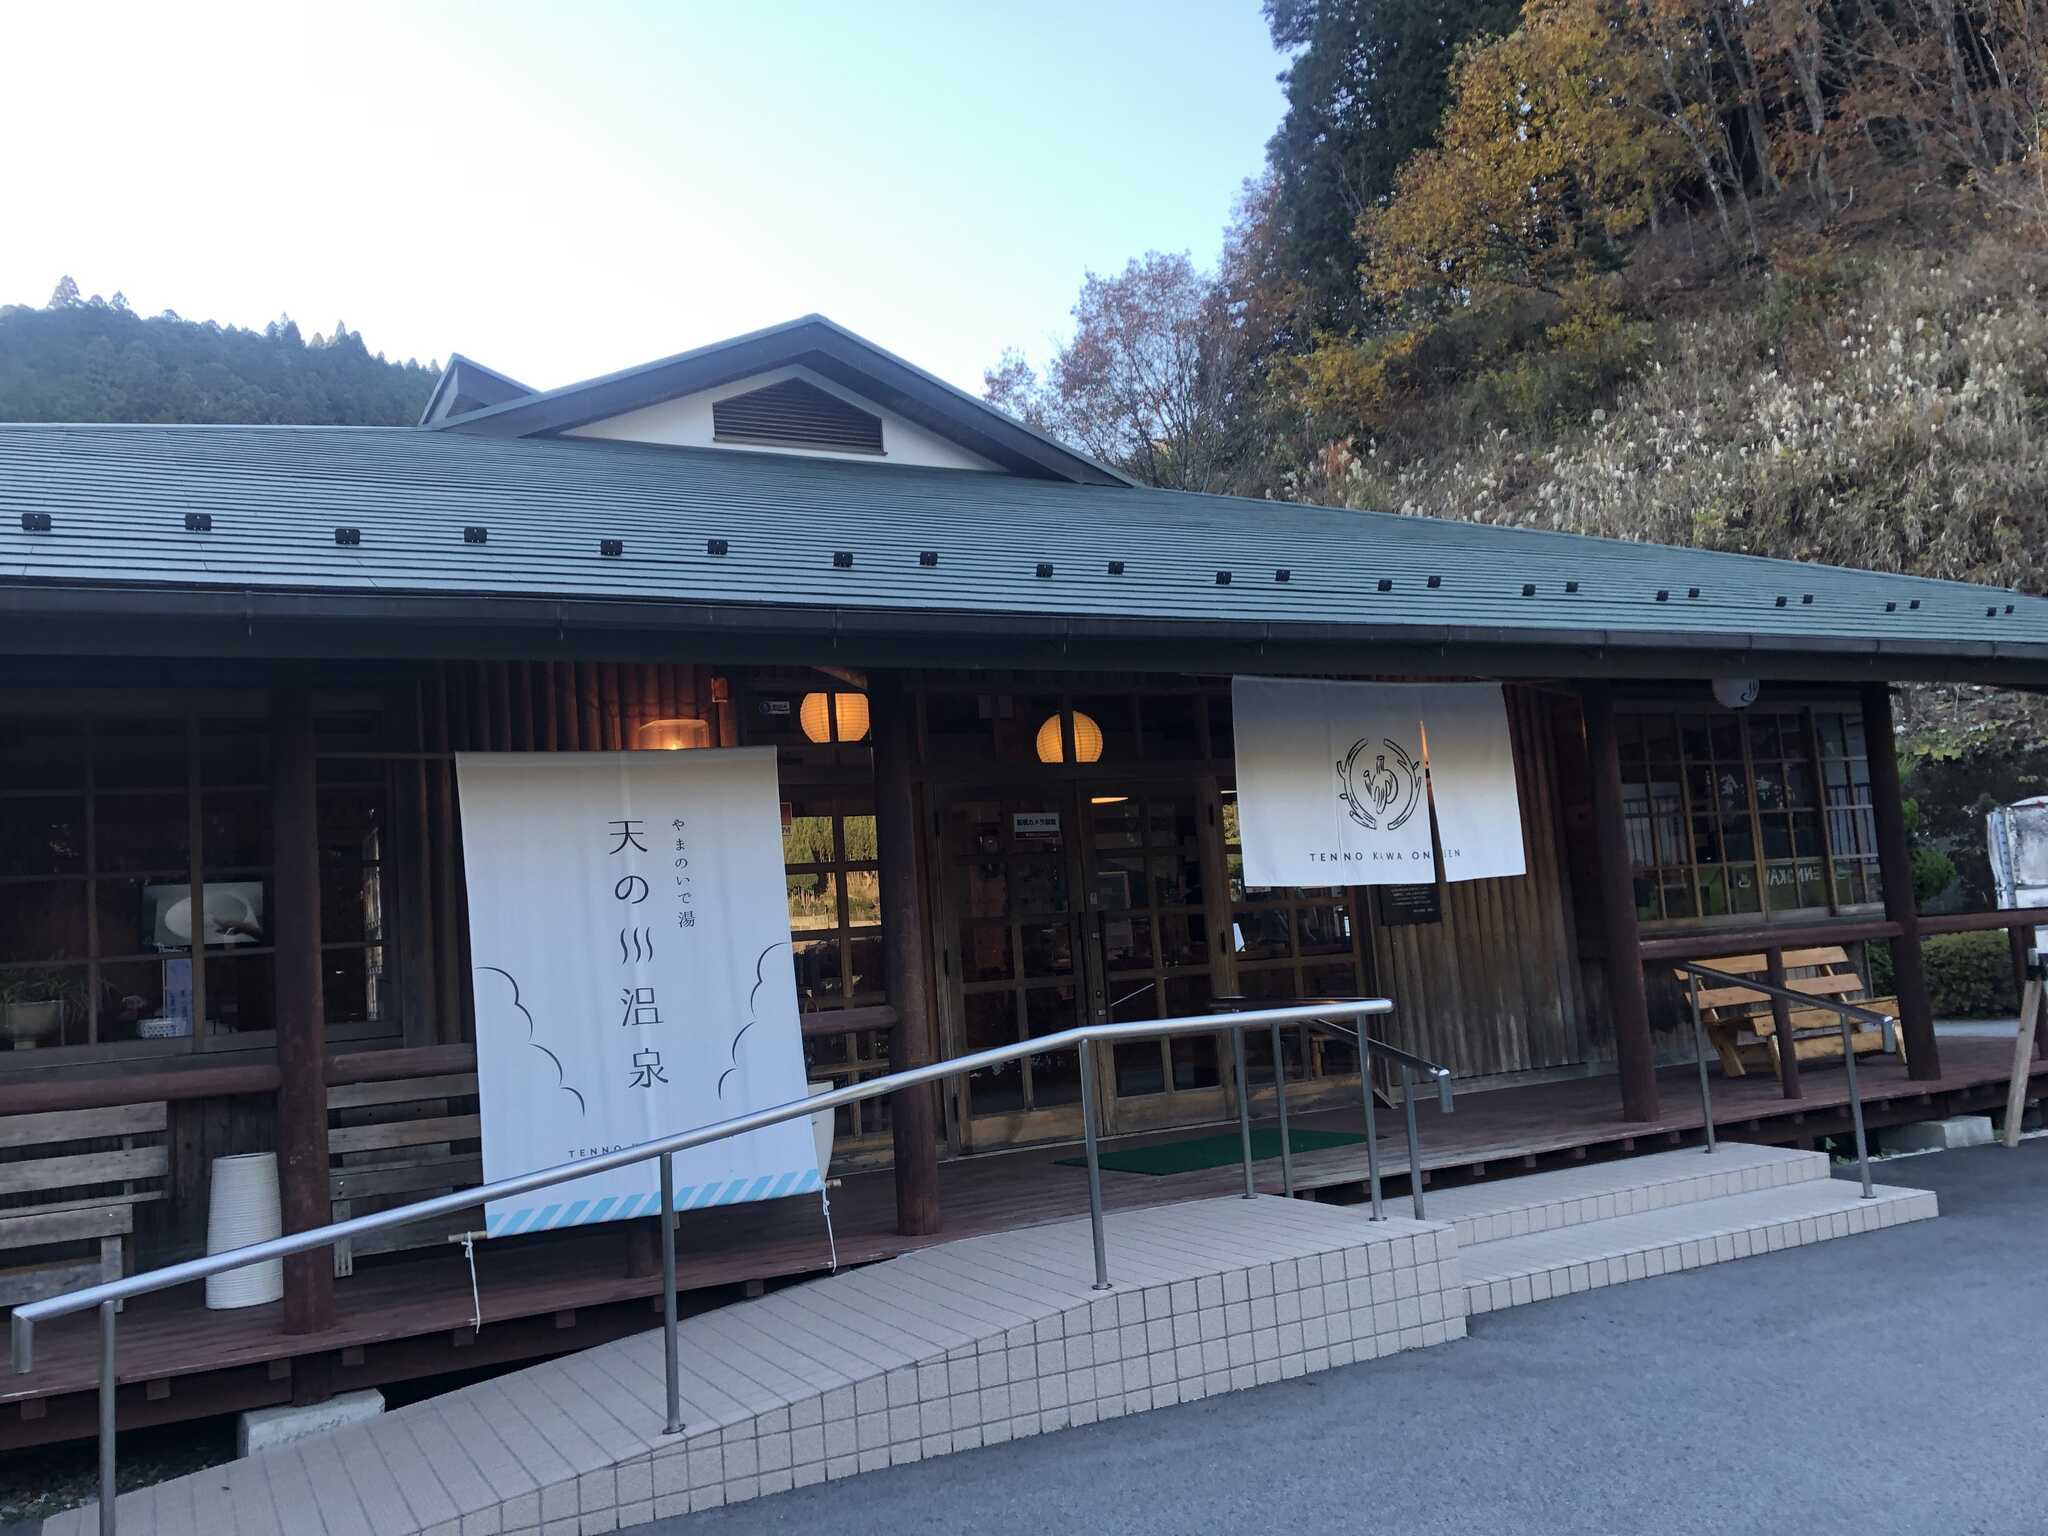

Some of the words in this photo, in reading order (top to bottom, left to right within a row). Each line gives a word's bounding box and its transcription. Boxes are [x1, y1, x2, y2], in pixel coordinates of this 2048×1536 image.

[1309, 851, 1363, 862] TENNO
[1411, 848, 1461, 861] ONEN
[672, 818, 696, 928] やまのいで湯
[567, 1144, 622, 1159] TENNO
